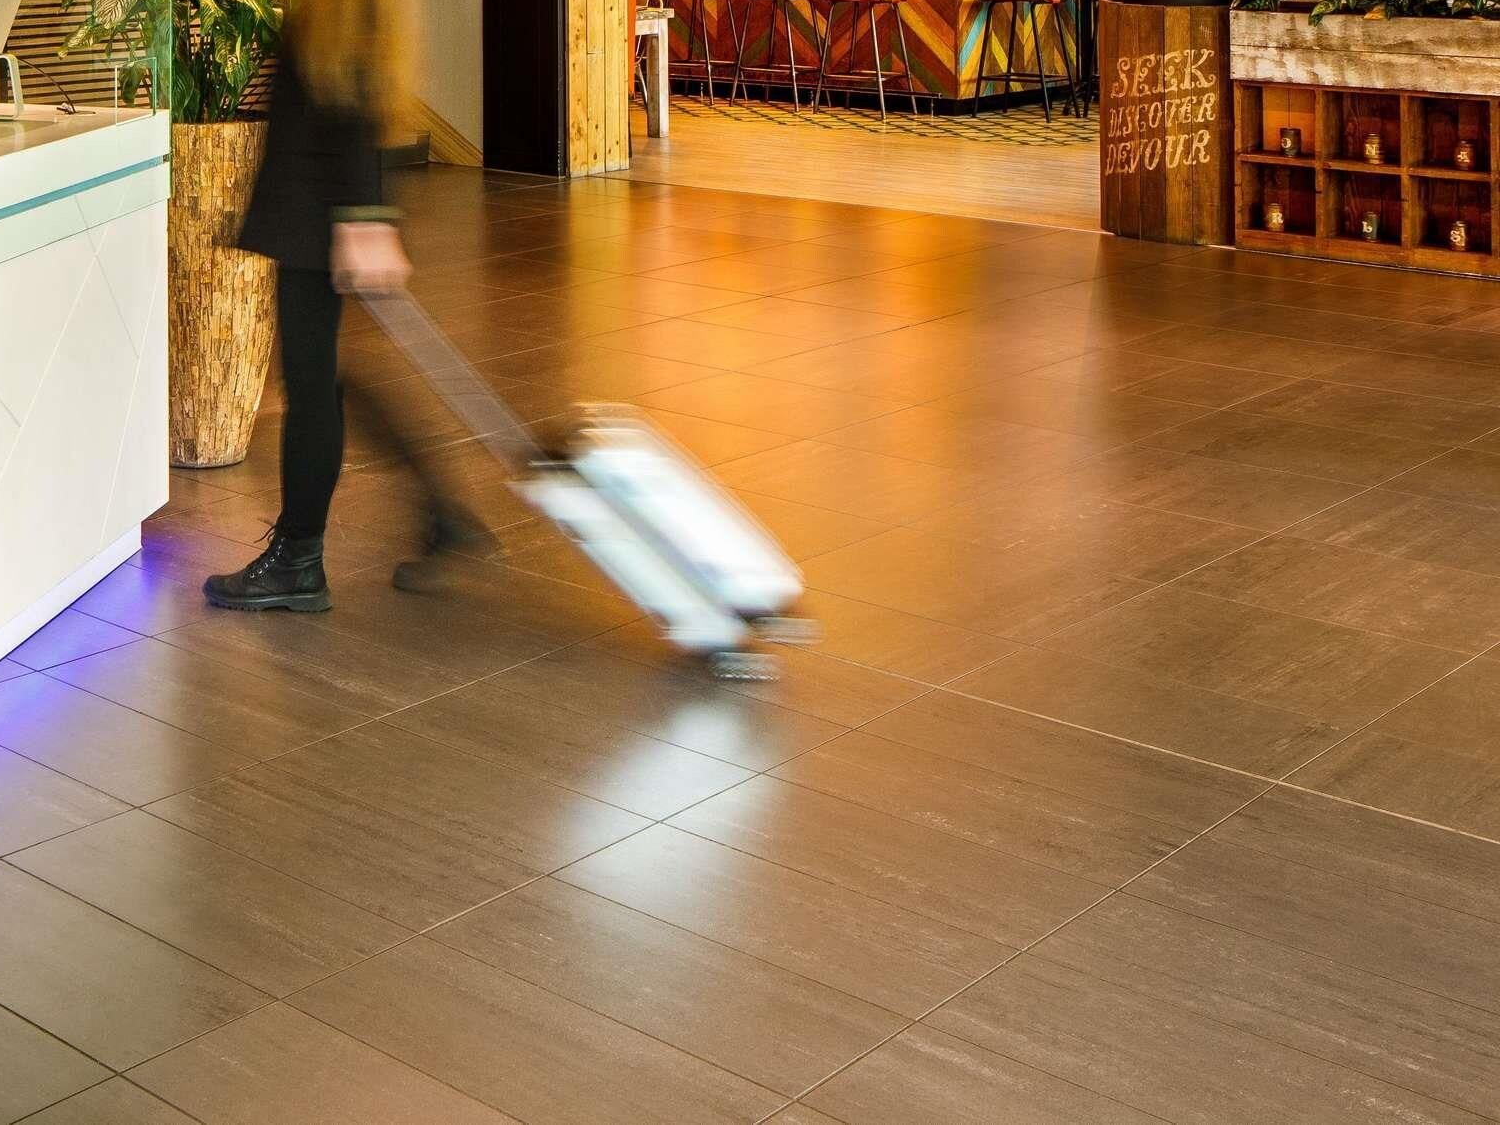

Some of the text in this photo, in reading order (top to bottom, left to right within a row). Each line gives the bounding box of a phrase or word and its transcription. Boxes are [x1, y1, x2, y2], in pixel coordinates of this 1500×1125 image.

[1110, 48, 1217, 98] SEEK
[1108, 92, 1216, 138] DISCOVER
[1105, 129, 1211, 177] DEVOUR
